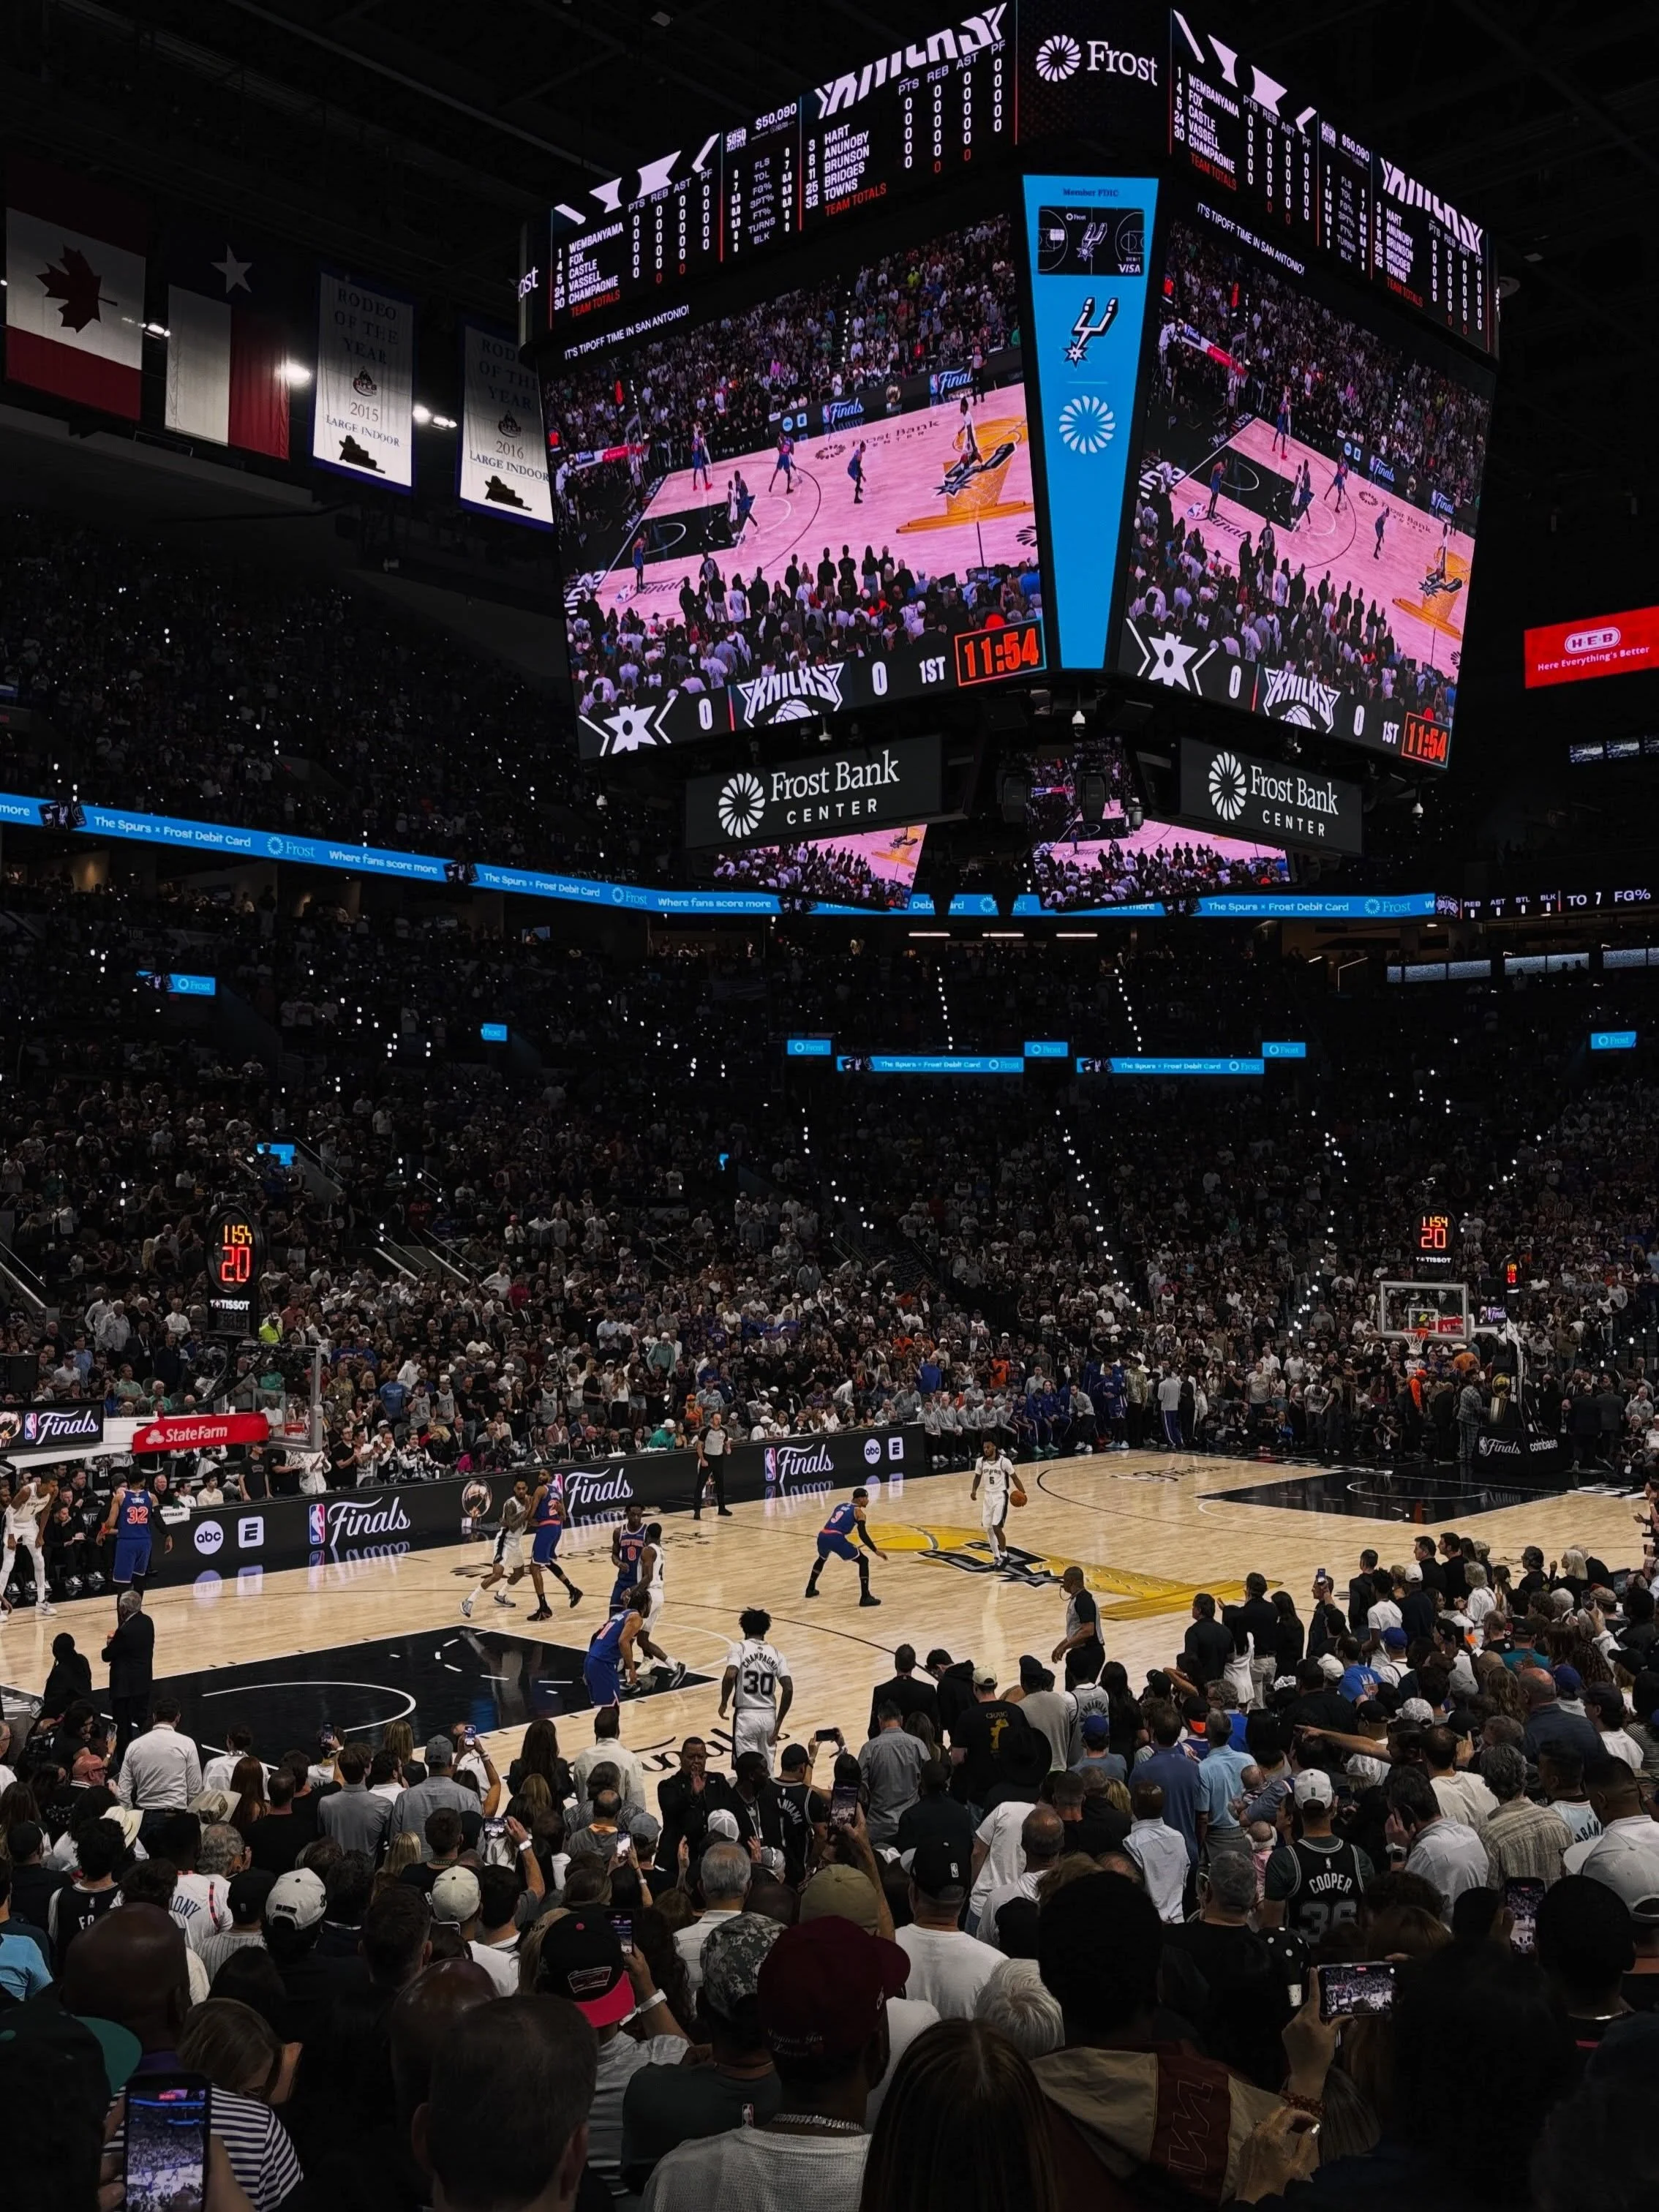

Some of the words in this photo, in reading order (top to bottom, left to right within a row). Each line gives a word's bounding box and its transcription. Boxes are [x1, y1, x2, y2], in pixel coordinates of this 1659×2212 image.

[898, 78, 919, 96] PTS
[927, 65, 949, 83] REB
[956, 52, 979, 71] AST
[990, 40, 1006, 55] PF
[1087, 40, 1158, 86] Frost
[1176, 83, 1182, 95] 4
[1189, 89, 1203, 109] FOX
[1177, 66, 1181, 79] 1
[1189, 73, 1239, 118] WEMBANYAMA
[824, 124, 850, 146] HART
[1174, 110, 1184, 127] 24
[1189, 118, 1219, 149] VASSELL
[808, 154, 816, 167] 8
[824, 130, 869, 160] ANUNOBY
[1189, 135, 1235, 174] CHAMPAGNIE
[808, 169, 816, 180] 11
[824, 145, 870, 174] BRUNSON
[824, 162, 865, 188] BRIDGES
[1191, 151, 1210, 174] TEAM
[754, 172, 770, 183] TOL
[824, 178, 858, 202] TOWNS
[628, 199, 645, 212] PTS
[651, 188, 669, 203] REB
[674, 178, 691, 194] AST
[701, 169, 712, 182] PF
[825, 198, 850, 217] TEAM
[852, 183, 887, 205] TOTALS
[1063, 188, 1096, 197] Member
[1097, 189, 1118, 197] FDIC
[748, 217, 776, 234] TURNS
[753, 207, 771, 220] FT%
[1386, 208, 1402, 227] HART
[557, 248, 563, 258] 1
[569, 222, 623, 254] WEMBANYAMA
[753, 232, 770, 245] BLK
[1197, 202, 1210, 218] IT'S
[1211, 210, 1235, 233] TIPOFF
[1237, 226, 1252, 244] TIME
[1253, 236, 1260, 249] IN
[1261, 241, 1274, 257] SAN
[1275, 250, 1305, 275] ANTONIO!
[557, 262, 563, 271] 4
[569, 252, 584, 267] FOX
[569, 259, 598, 279] CASTLE
[1118, 263, 1141, 274] VISA
[554, 285, 564, 298] 24
[568, 271, 601, 292] VASSELL
[554, 298, 565, 310] 30
[569, 275, 618, 304] CHAMPAGNIE
[338, 287, 396, 320] RODEO
[571, 301, 591, 317] TEAM
[592, 290, 620, 310] TOTALS
[334, 310, 356, 328] OF
[364, 320, 399, 345] THE
[565, 348, 578, 360] IT'S
[579, 336, 605, 355] TIPOFF
[606, 331, 625, 345] TIME
[626, 327, 634, 336] IN
[636, 318, 651, 332] SAN
[652, 304, 689, 327] ANTONIO!
[341, 336, 387, 364] YEAR
[482, 338, 516, 361] ROD
[479, 361, 502, 378] OF
[487, 385, 532, 410] YEAR
[350, 402, 379, 422] 2015
[831, 399, 864, 424] Finals
[326, 414, 358, 433] LARGE
[361, 426, 399, 447] INDOOR
[496, 440, 524, 459] 2016
[470, 450, 503, 470] LARGE
[507, 463, 549, 483] INDOOR
[1538, 662, 1559, 672] Here
[1561, 652, 1617, 667] Everything's
[1620, 646, 1650, 658] Better
[698, 698, 713, 730] 0
[872, 661, 887, 696] 0
[919, 655, 947, 685] 1ST
[964, 627, 1039, 678] 11:54
[1229, 665, 1241, 699] 0
[1353, 705, 1365, 737] 0
[1382, 721, 1399, 745] 1ST
[1408, 721, 1448, 762] 11:54
[770, 767, 830, 802] Frost
[835, 749, 900, 792] Bank
[1250, 764, 1293, 804] Frost
[1296, 777, 1339, 816] Bank
[786, 798, 878, 824] CENTER
[1263, 810, 1325, 837] CENTER
[94, 816, 116, 828] The
[118, 821, 151, 834] Spurs
[163, 826, 193, 839] Frost
[195, 831, 223, 843] Debit
[225, 835, 251, 848] Card
[285, 840, 315, 858] Frost
[329, 849, 360, 863] Where
[363, 854, 384, 866] fans
[385, 858, 412, 870] score
[413, 863, 438, 875] more
[484, 873, 499, 883] The
[502, 876, 527, 887] Spurs
[535, 881, 557, 891] Frost
[558, 884, 579, 895] Debit
[581, 887, 600, 898] Card
[626, 891, 647, 905] Frost
[1567, 894, 1587, 906] TO
[1595, 892, 1602, 905] 7
[1614, 889, 1651, 903] FG%
[658, 898, 689, 907] Where
[691, 897, 714, 907] fans
[745, 900, 771, 908] more
[1208, 903, 1226, 911] The
[1229, 903, 1257, 911] Spurs
[1268, 903, 1295, 911] Frost
[1297, 903, 1323, 911] Debit
[1325, 903, 1349, 911] Card
[1382, 900, 1411, 912] Frost
[189, 980, 211, 991] Frost
[1423, 1216, 1448, 1227] 11:54
[225, 1225, 252, 1244] 11:54
[1421, 1228, 1446, 1248] 20
[222, 1246, 250, 1282] 20
[221, 1299, 250, 1310] TISSOT
[36, 1410, 99, 1445] Finals
[865, 1445, 880, 1456] abc
[1487, 1438, 1521, 1457] Finals
[1530, 1437, 1558, 1452] coinbase
[777, 1443, 834, 1483] Finals
[565, 1467, 633, 1513] Finals
[127, 1506, 148, 1524] 32
[327, 1496, 411, 1546] Finals
[196, 1530, 222, 1543] abc
[742, 1652, 778, 1670] CHAMPAGNI
[743, 1671, 774, 1696] 30
[1309, 1873, 1353, 1895] COOPER
